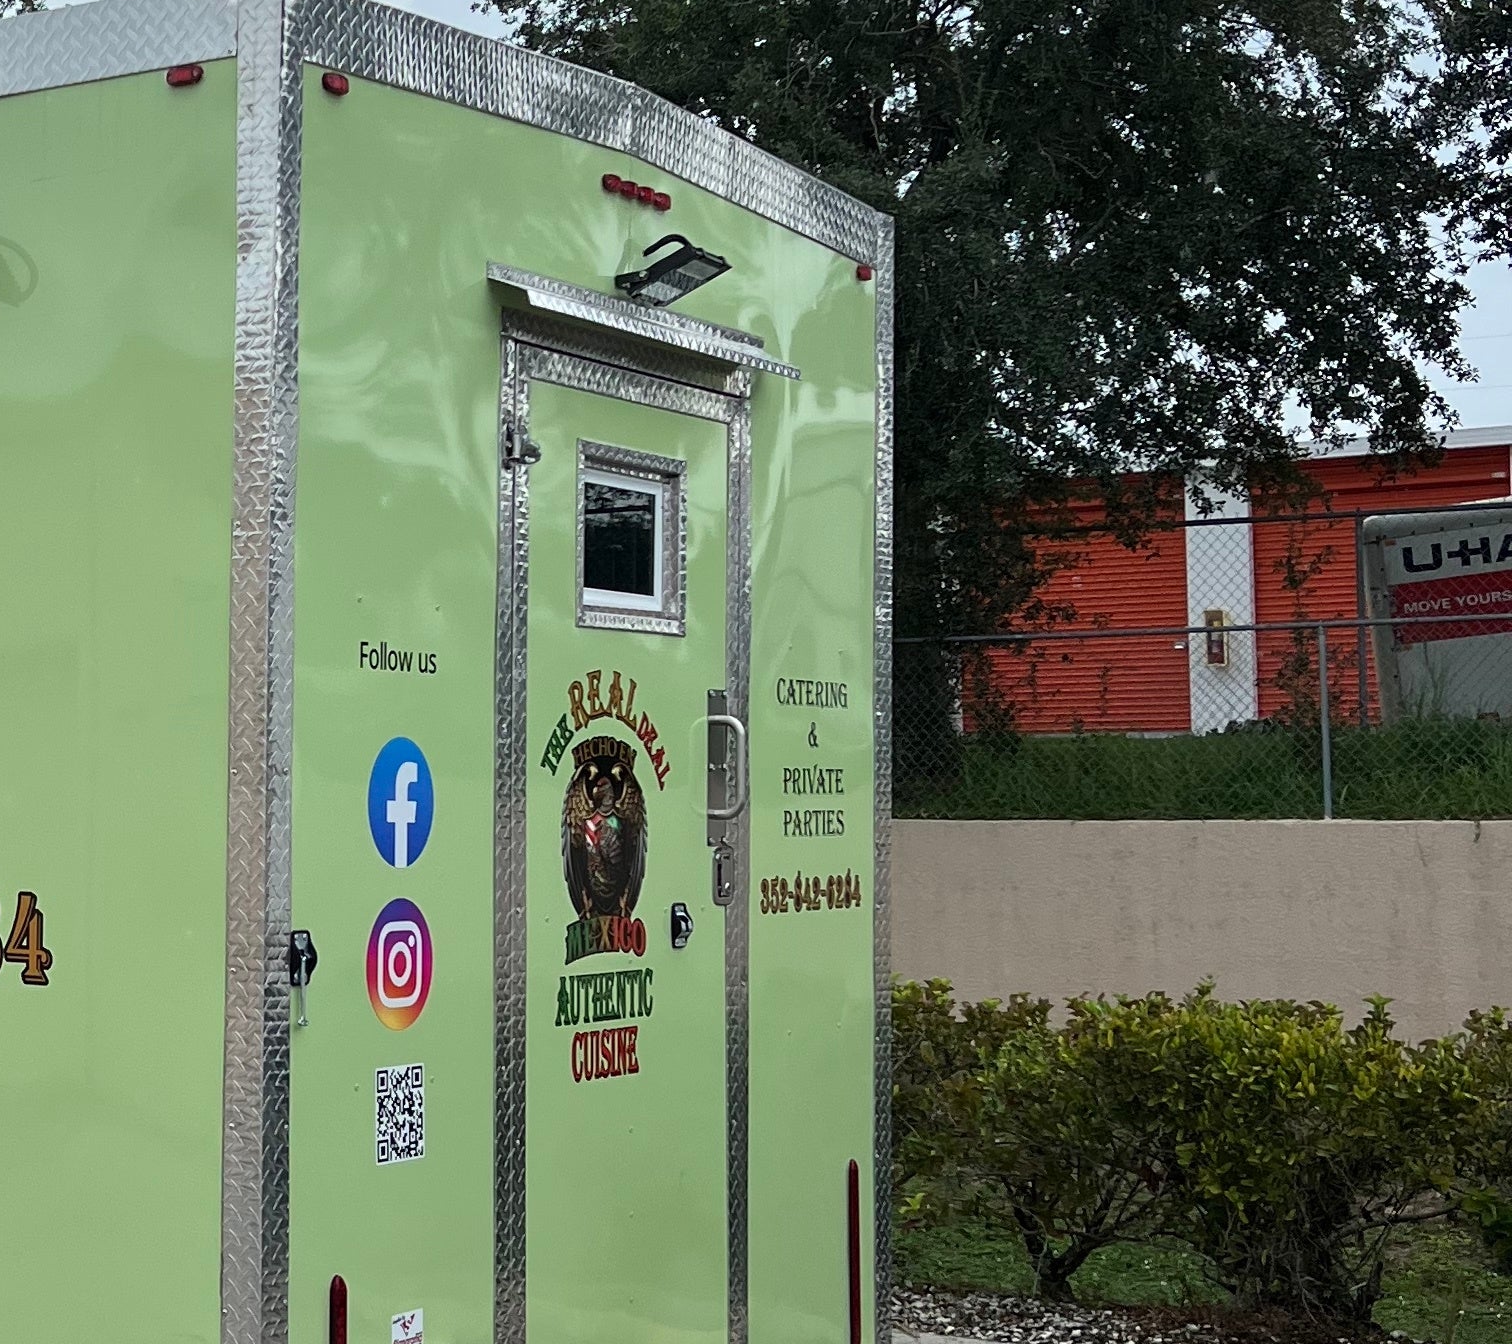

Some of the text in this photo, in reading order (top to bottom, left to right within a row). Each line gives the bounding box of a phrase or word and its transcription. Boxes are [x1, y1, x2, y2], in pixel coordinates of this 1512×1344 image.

[1404, 597, 1451, 613] MOVE
[360, 641, 437, 674] Follow us
[776, 677, 848, 708] CATERING
[540, 669, 670, 791] THE REAL DEAL
[807, 722, 819, 748] &
[573, 738, 637, 768] HECHO EN
[783, 763, 845, 795] PRIVATE
[783, 809, 846, 837] PARTIES
[760, 868, 862, 915] 352-842-6284
[565, 915, 646, 965] MEXICO
[555, 967, 653, 1026] AUTHENTIC
[571, 1026, 640, 1083] CUISINE
